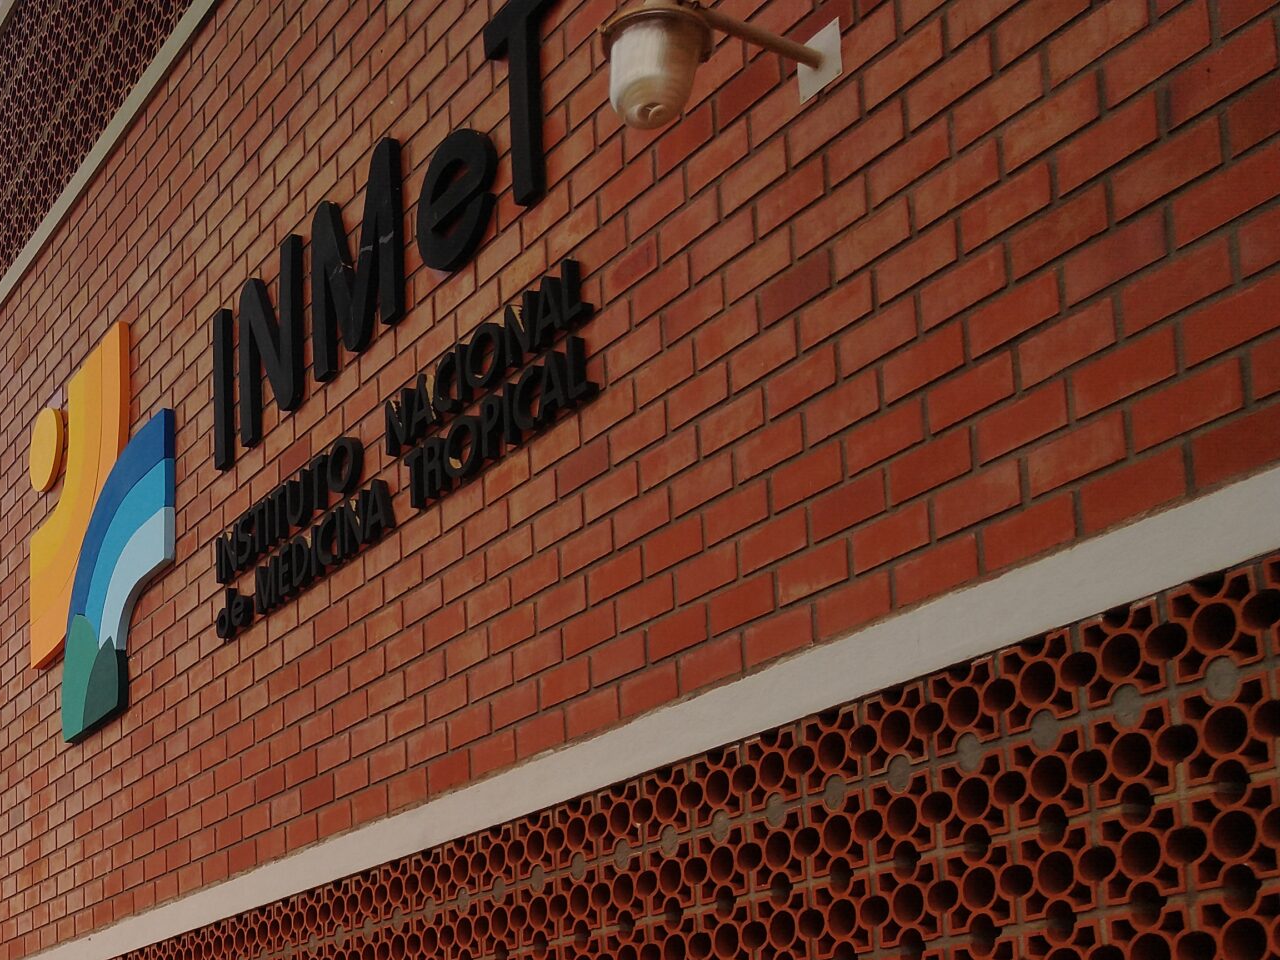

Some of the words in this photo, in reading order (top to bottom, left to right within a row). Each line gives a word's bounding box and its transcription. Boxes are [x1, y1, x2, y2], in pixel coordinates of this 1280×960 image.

[213, 0, 560, 471] INMeT
[216, 436, 365, 584] INSTITUTO
[385, 258, 594, 457] NACIONAL
[216, 587, 254, 639] de
[255, 478, 396, 615] MEDICINA
[405, 335, 600, 508] TROPICAL
